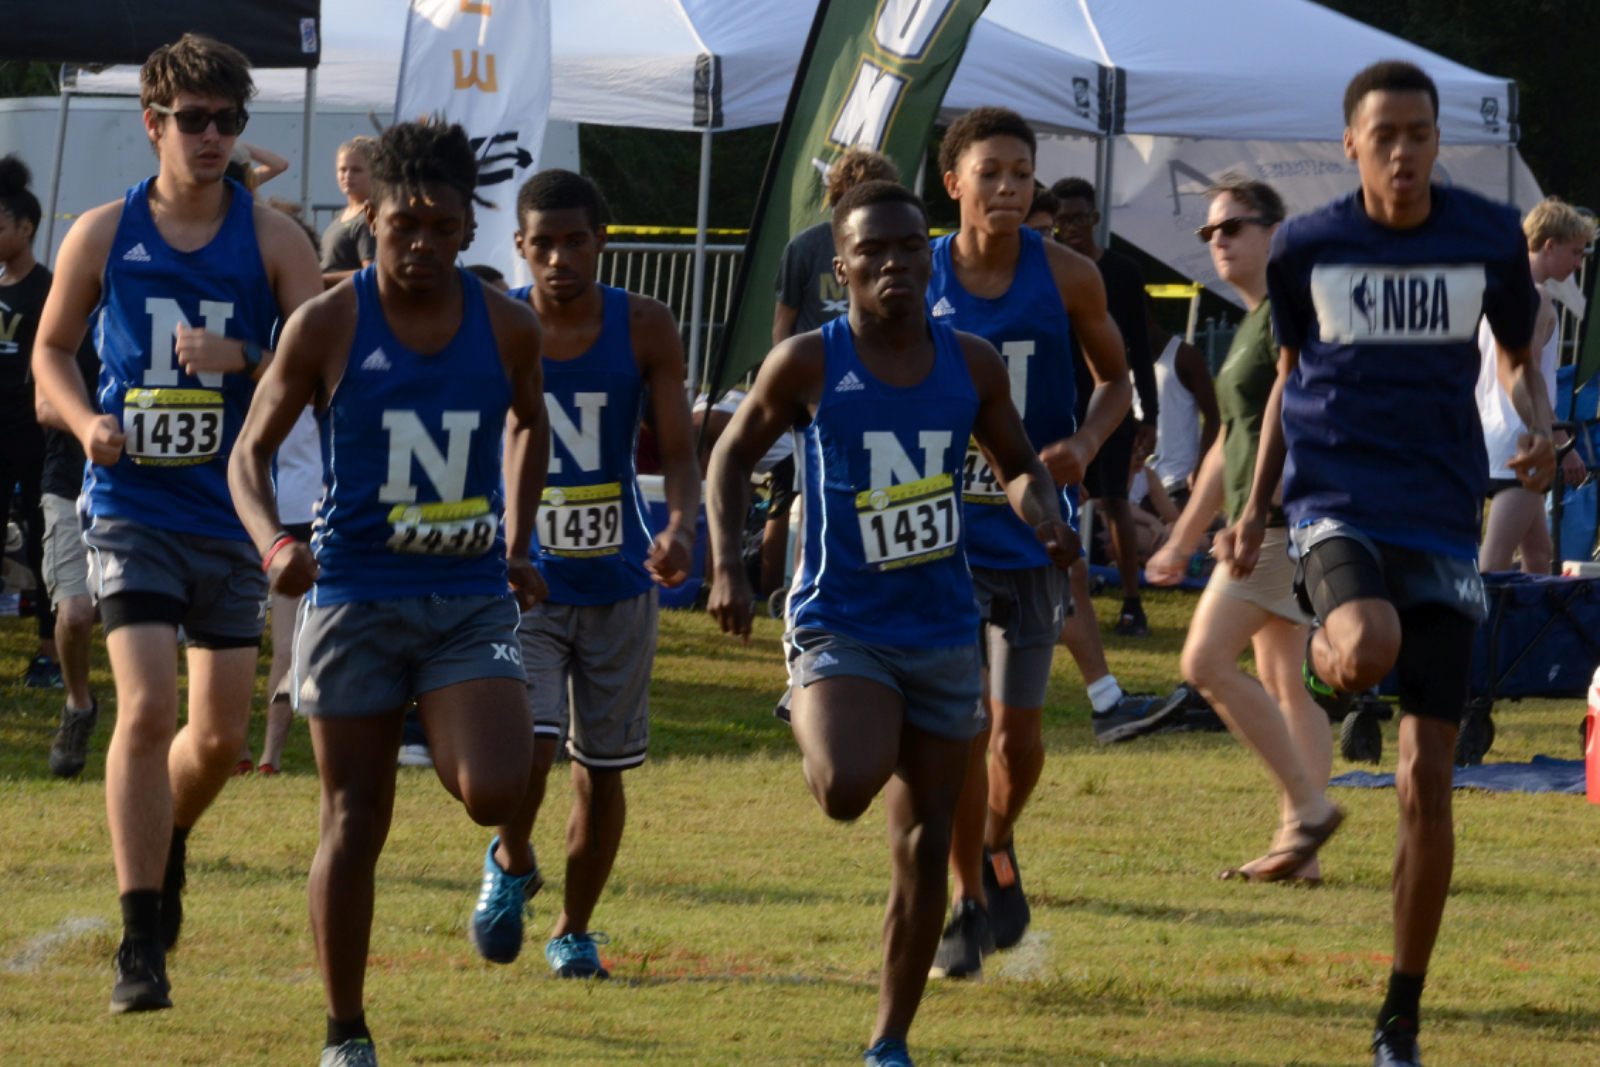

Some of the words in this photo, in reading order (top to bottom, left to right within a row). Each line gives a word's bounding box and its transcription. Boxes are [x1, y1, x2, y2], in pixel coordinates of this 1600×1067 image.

[1383, 274, 1450, 334] NBA
[143, 297, 234, 388] N
[133, 412, 218, 454] 1433
[378, 409, 480, 503] N
[543, 392, 608, 474] N
[863, 430, 952, 491] N
[546, 505, 619, 547] 1439
[871, 497, 954, 558] 1437
[490, 642, 520, 666] XC
